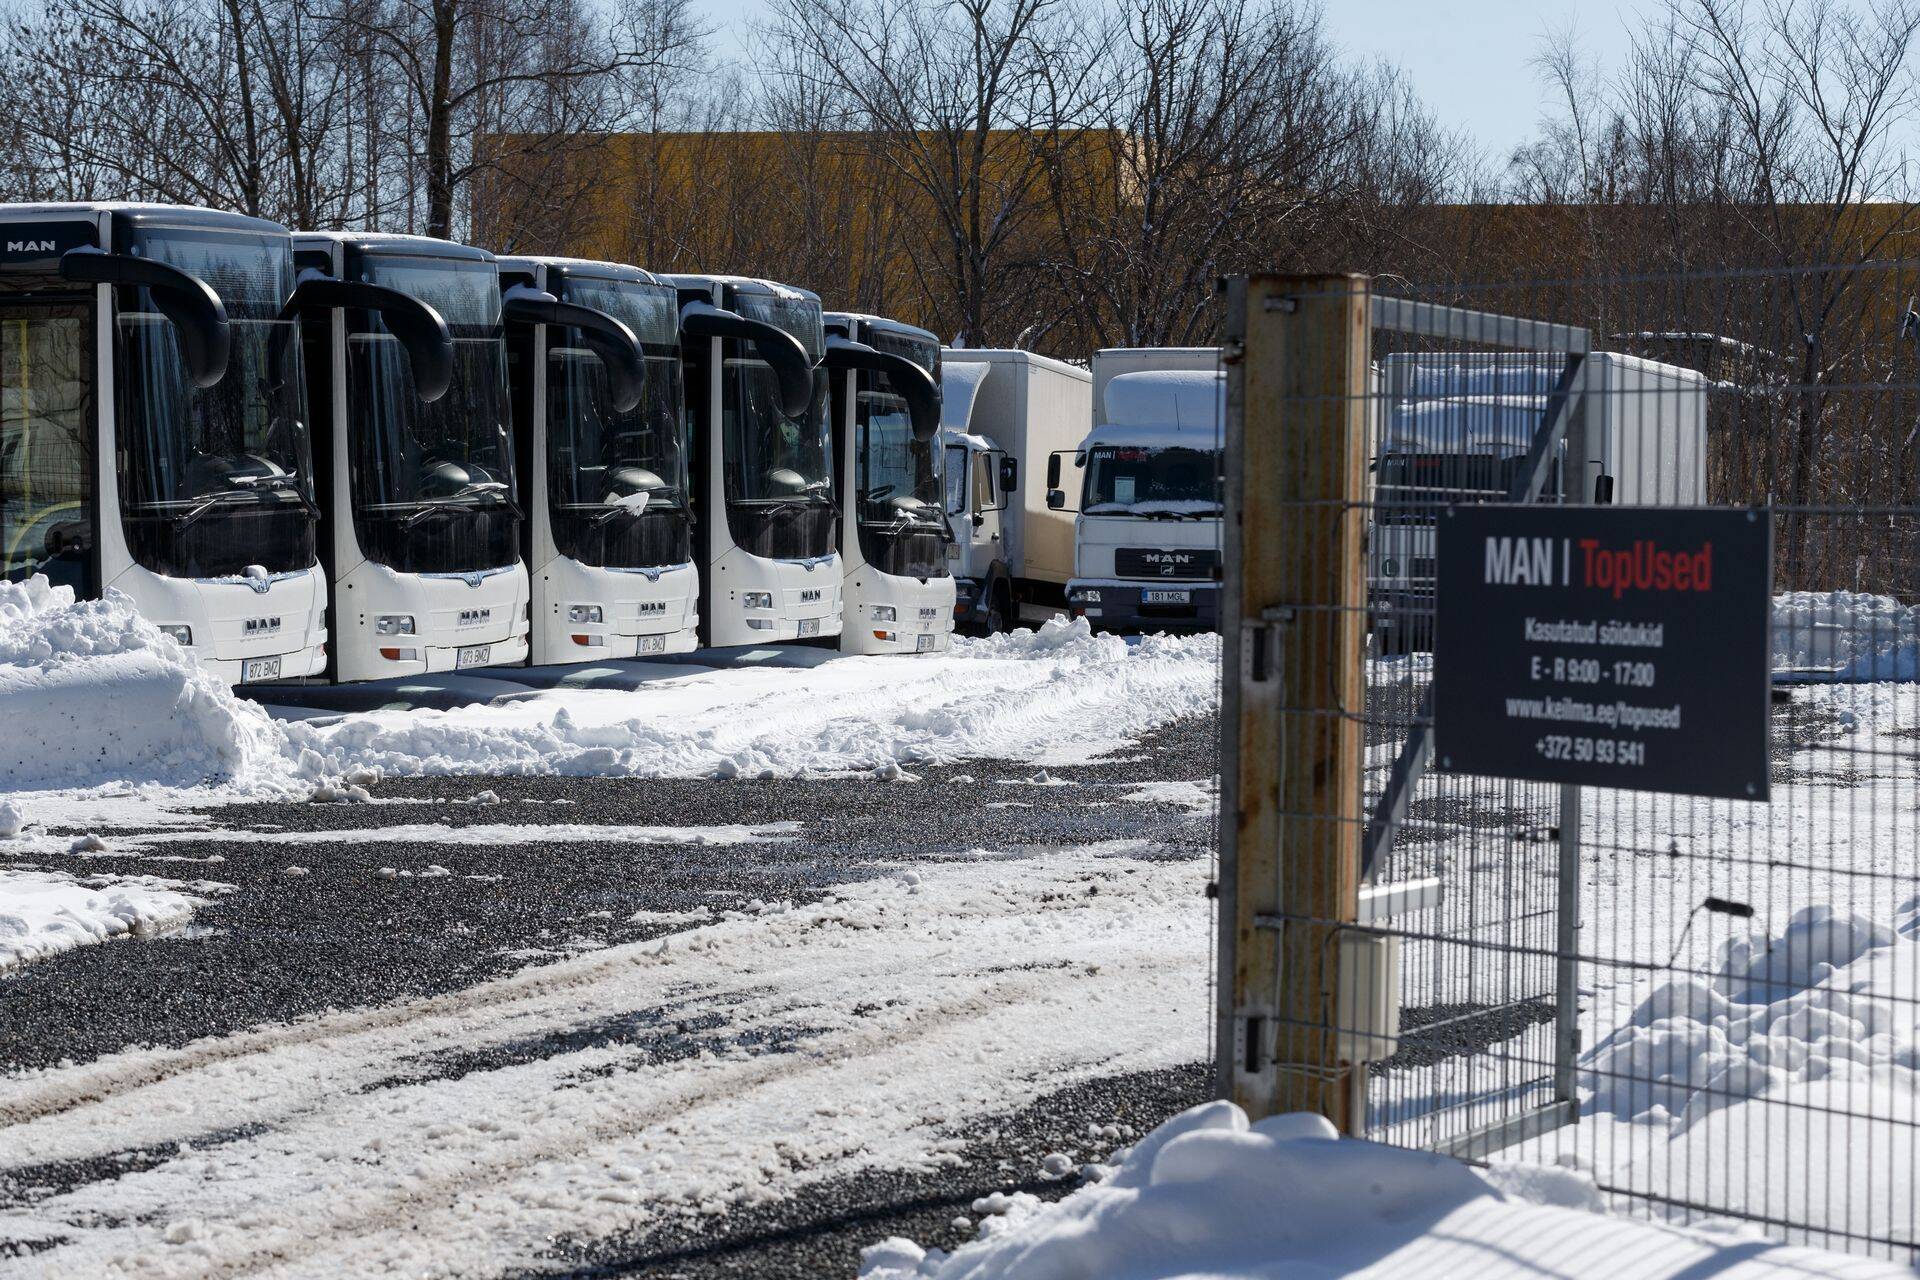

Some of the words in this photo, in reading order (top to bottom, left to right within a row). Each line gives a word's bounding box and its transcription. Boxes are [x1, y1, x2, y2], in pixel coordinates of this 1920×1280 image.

[7, 240, 56, 251] MAN
[1094, 451, 1113, 460] MAN
[1146, 553, 1190, 563] MAN
[1485, 536, 1552, 586] MAN
[1579, 539, 1713, 600] TopUsed
[801, 590, 821, 601] MAN
[1151, 592, 1165, 601] 181
[1167, 592, 1185, 601] MGL
[640, 602, 666, 612] MAN
[459, 609, 490, 622] MAN
[245, 617, 281, 632] MAN
[1525, 617, 1598, 644] Kasutatud
[1599, 620, 1664, 648] sõidukid
[249, 663, 262, 679] 872
[263, 660, 279, 677] BMZ
[1531, 656, 1542, 680] E
[1554, 658, 1566, 682] R
[1567, 658, 1600, 684] 9:00
[1612, 661, 1656, 688] 17:00
[1536, 735, 1573, 760] +372
[1574, 737, 1594, 762] 50
[1596, 739, 1616, 764] 93
[1617, 741, 1646, 766] 541
